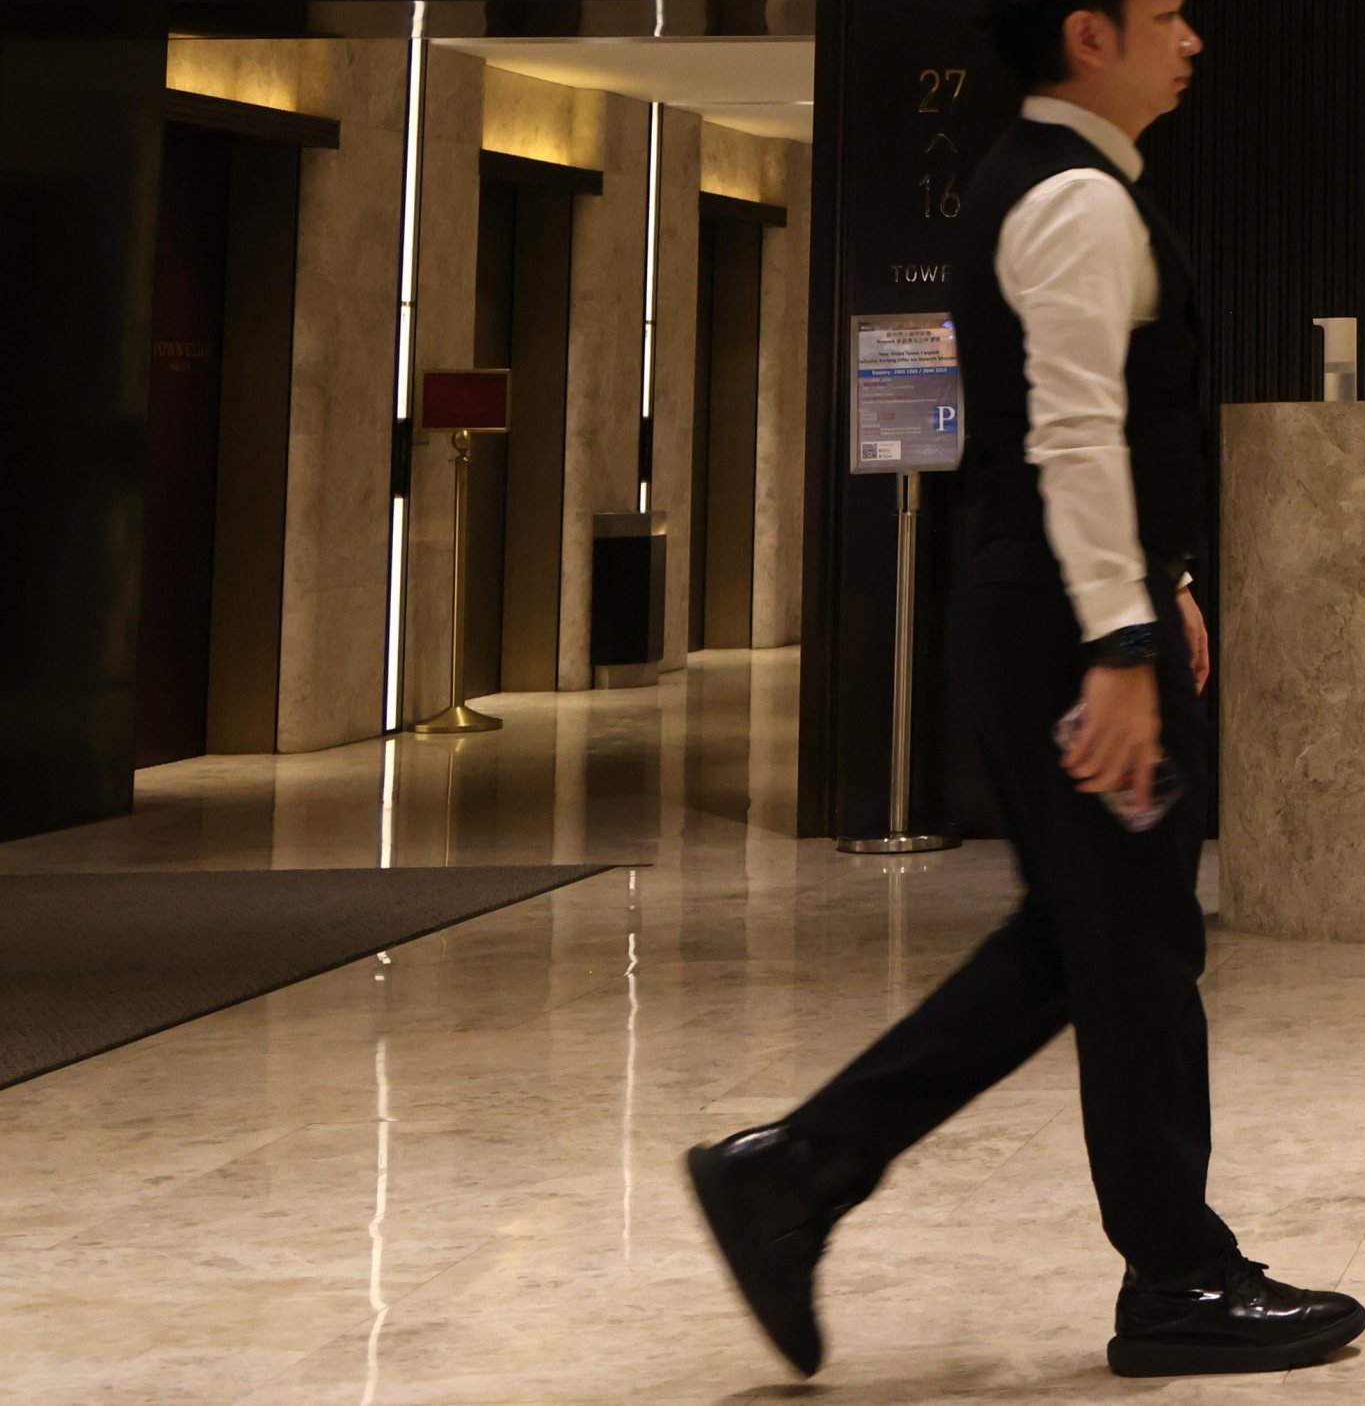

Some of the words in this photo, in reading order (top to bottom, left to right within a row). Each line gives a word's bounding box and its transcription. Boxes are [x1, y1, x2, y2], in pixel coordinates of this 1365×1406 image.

[919, 68, 966, 113] 27
[918, 174, 961, 218] 16
[935, 405, 956, 432] P
